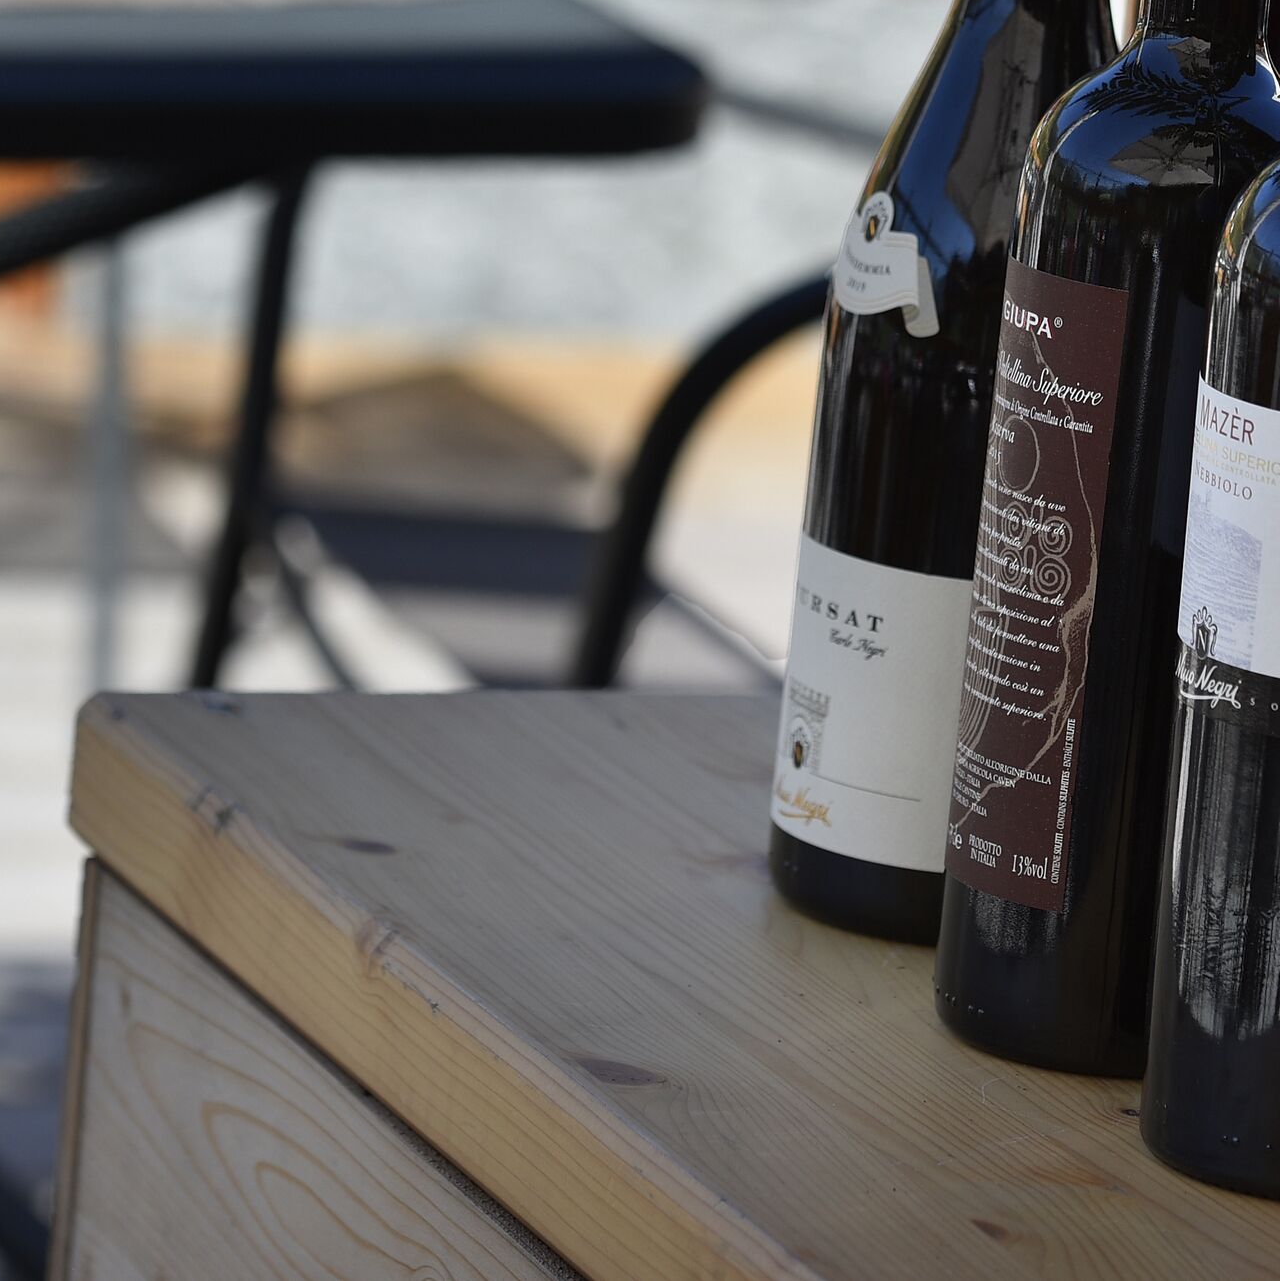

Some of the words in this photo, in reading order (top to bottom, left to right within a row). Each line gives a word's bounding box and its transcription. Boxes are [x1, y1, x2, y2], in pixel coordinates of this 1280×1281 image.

[1032, 367, 1104, 406] Superiore
[1034, 494, 1046, 508] da
[1021, 515, 1052, 535] vitigni
[1053, 523, 1066, 536] di
[1050, 594, 1065, 607] da
[1040, 616, 1055, 628] al
[1038, 641, 1061, 654] una
[1195, 664, 1242, 709] Negri
[993, 774, 1017, 789] CAVEN
[1026, 771, 1052, 785] DALLA
[969, 833, 1002, 857] PRODOTTO
[977, 851, 996, 868] ITALIA
